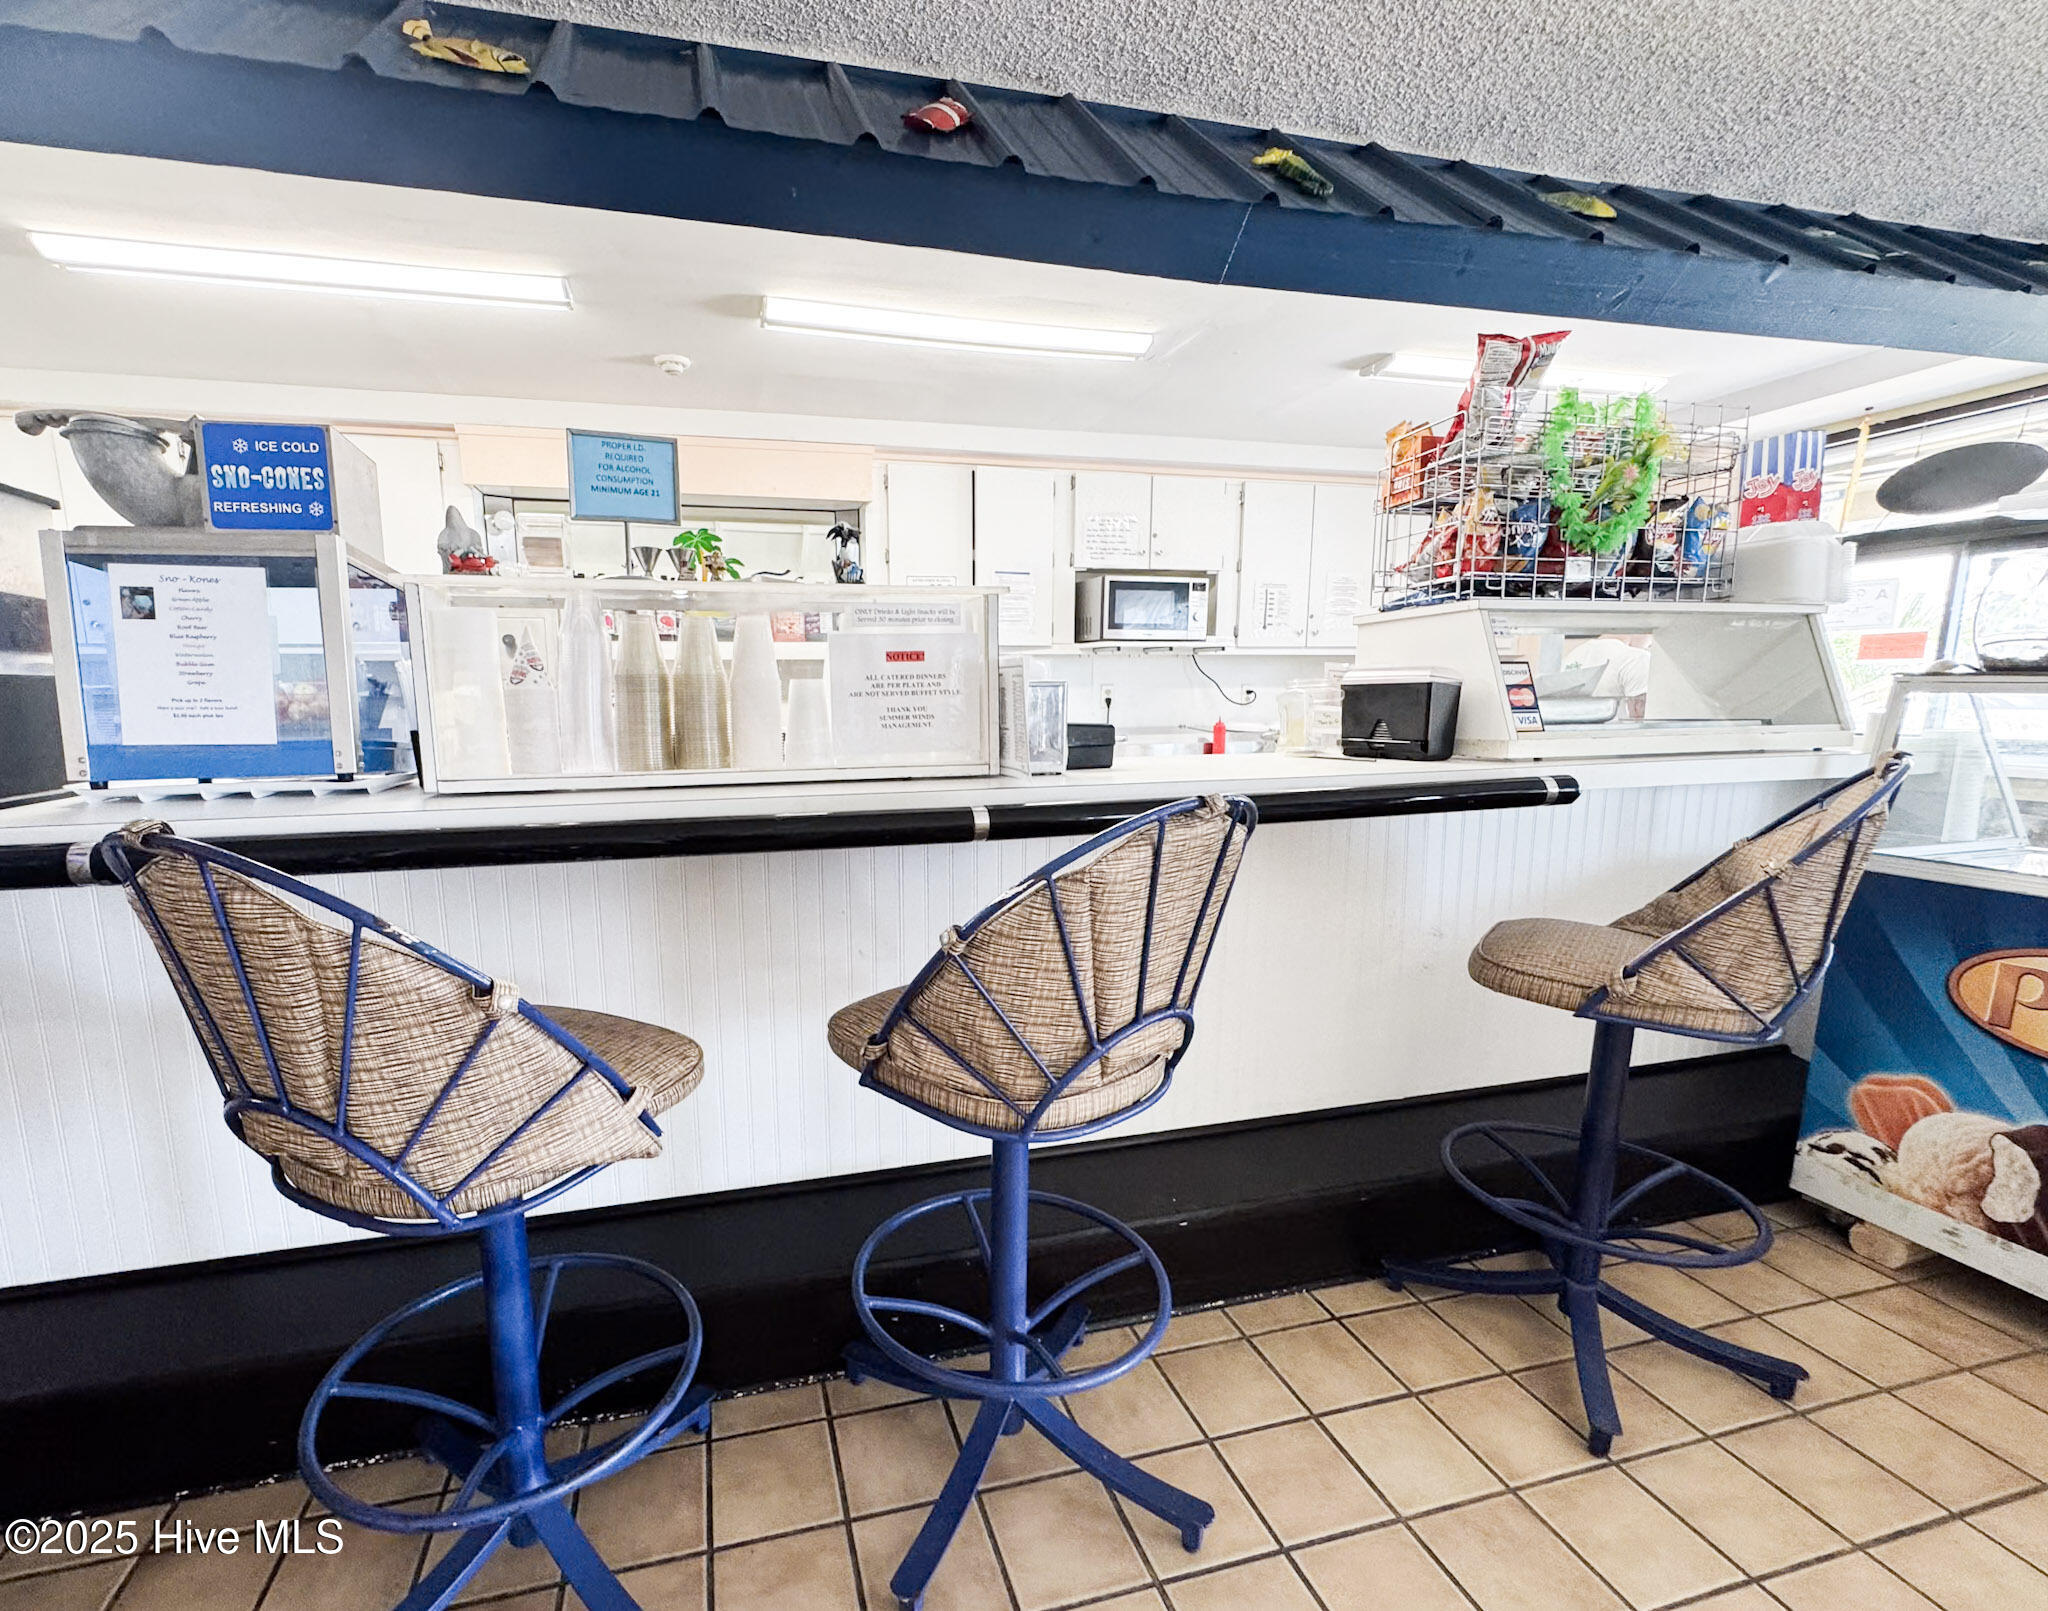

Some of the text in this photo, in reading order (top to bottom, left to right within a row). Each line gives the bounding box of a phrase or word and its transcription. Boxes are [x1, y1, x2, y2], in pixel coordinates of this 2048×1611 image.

[255, 440, 319, 453] ICE COLD
[601, 440, 631, 451] PROPER
[605, 452, 644, 462] REQUIRED
[598, 463, 650, 474] FOR ALCOHOL
[210, 464, 325, 490] SNO-CONES
[595, 474, 653, 485] CONSUMPTION
[590, 484, 660, 497] MINIMUM AGE 21
[213, 501, 302, 514] REFRESHING
[1516, 716, 1539, 725] VISA
